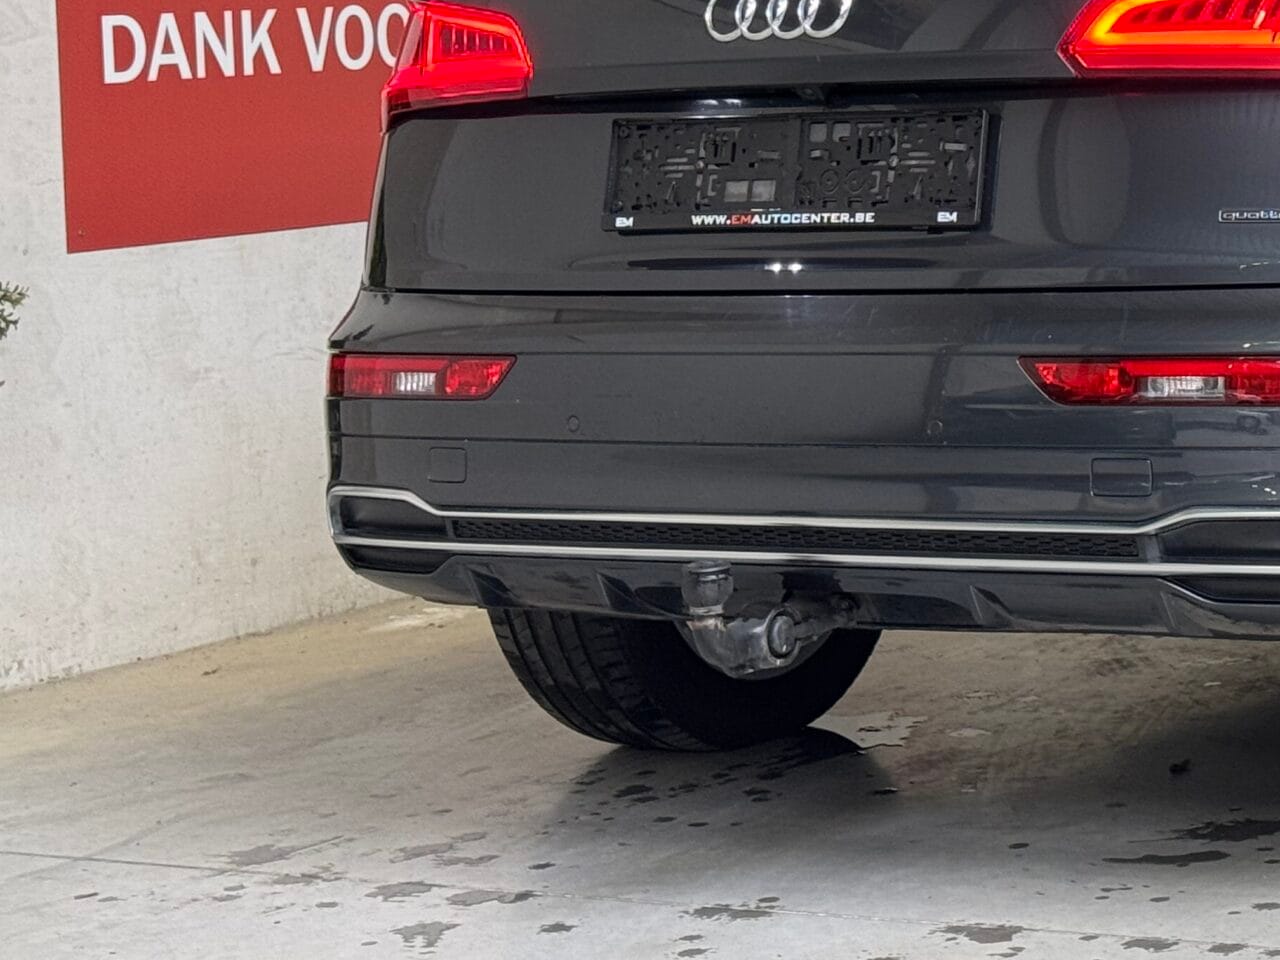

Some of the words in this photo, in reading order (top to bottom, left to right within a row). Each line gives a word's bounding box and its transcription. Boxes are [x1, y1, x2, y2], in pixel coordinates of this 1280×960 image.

[101, 8, 282, 84] DANK
[614, 216, 634, 228] EM
[690, 212, 876, 226] WWW.EMAUTOCENTER.BE
[936, 211, 958, 223] EM
